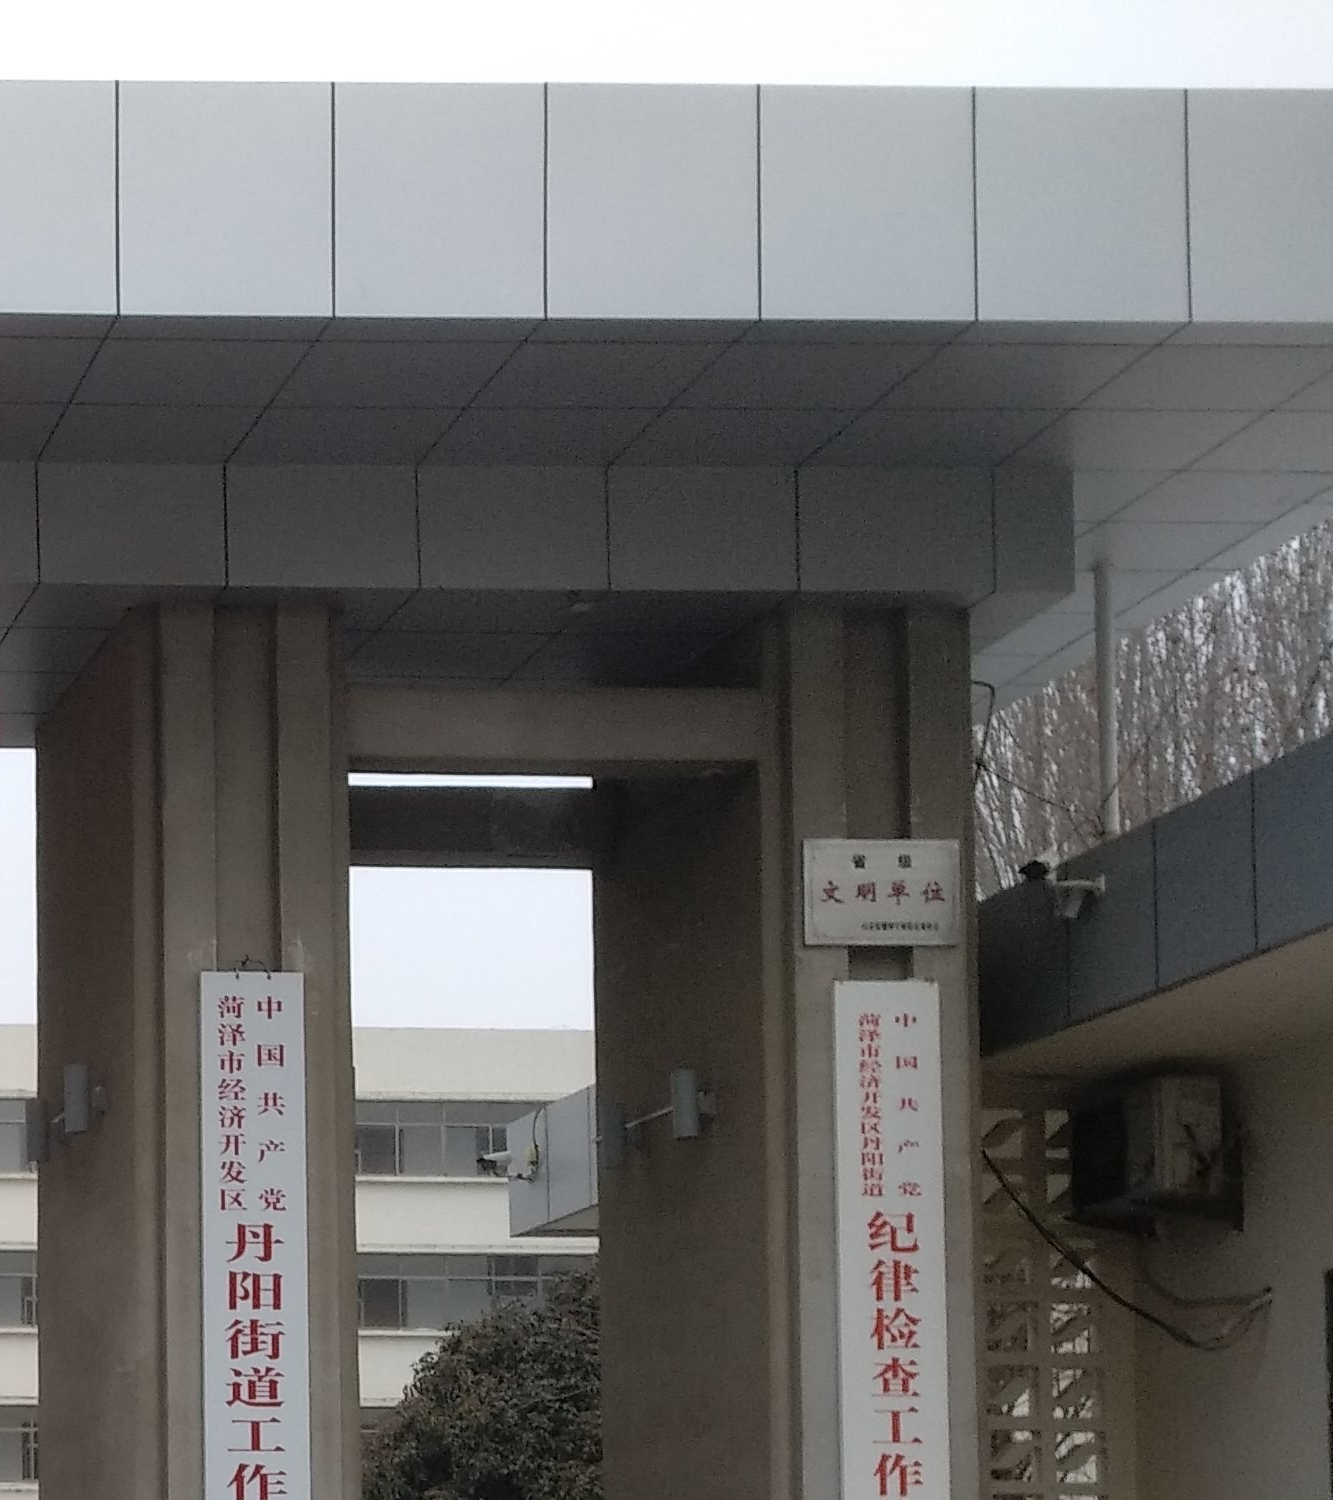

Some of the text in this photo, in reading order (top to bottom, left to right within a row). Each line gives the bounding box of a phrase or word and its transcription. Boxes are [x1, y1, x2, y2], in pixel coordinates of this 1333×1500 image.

[820, 879, 946, 906] 文明单位
[216, 995, 249, 1212] 菏泽市经济开发区
[255, 995, 288, 1212] 中国共产党
[857, 1012, 886, 1198] 菏泽市经济开发区丹阳街道
[893, 1011, 923, 1197] 中国共产党
